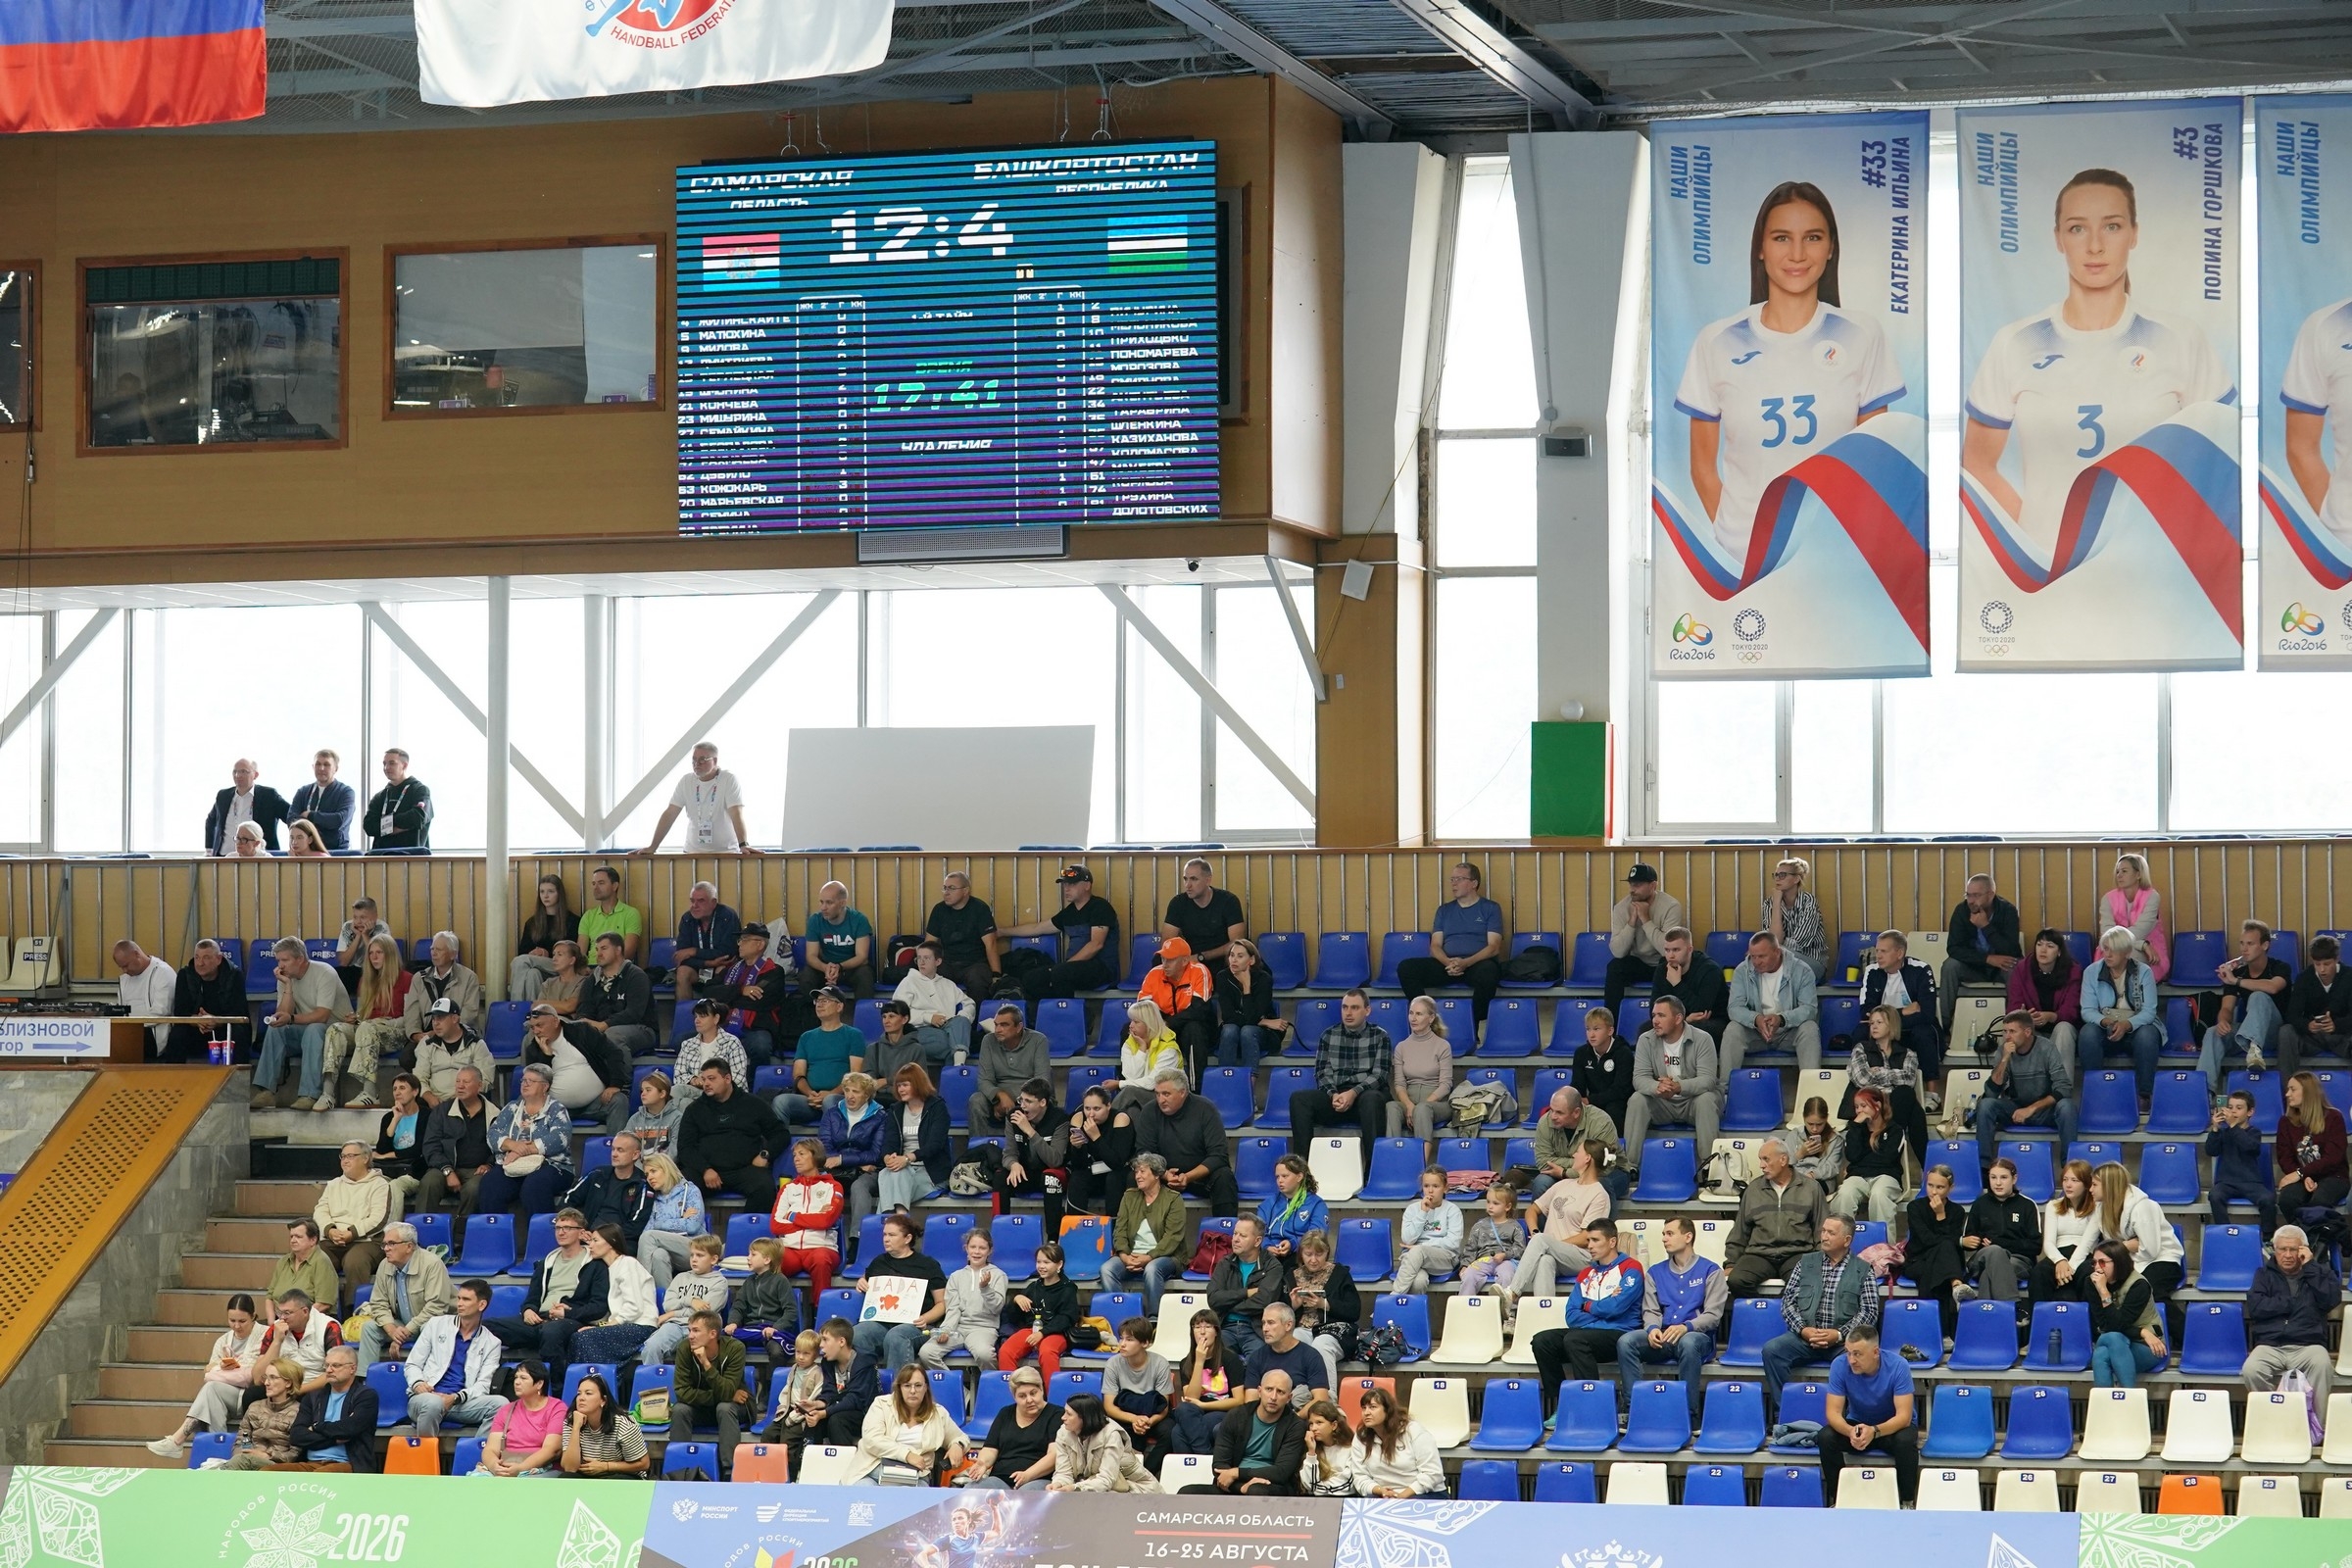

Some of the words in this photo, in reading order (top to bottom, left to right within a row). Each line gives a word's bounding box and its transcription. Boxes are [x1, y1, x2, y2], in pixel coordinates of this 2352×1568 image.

[610, 25, 679, 49] HANDBALL
[681, 0, 736, 44] FEDERAT
[2173, 125, 2199, 161] #3
[2277, 122, 2295, 176] НАШИ
[973, 152, 1200, 180] БАШКОРТОСТАН
[1861, 139, 1887, 189] #33
[1977, 131, 1994, 186] НАШИ
[1670, 145, 1689, 200] НАШИ
[1891, 136, 1910, 209] ИЛЬИНА
[2203, 122, 2223, 221] ГОРШКОВА
[690, 170, 855, 194] САМАРСКАЯ
[2296, 121, 2321, 245] ОЛИМПИЙЦЫ
[1995, 131, 2019, 254] ОЛИМПИЙЦЫ
[730, 197, 808, 210] ОБЛАСТЬ
[1689, 144, 1713, 266] ОЛИМПИЙЦЫ
[829, 203, 1014, 264] 12:4
[1890, 215, 1909, 315] ЕКАТЕРИНА
[2203, 227, 2222, 301] ПОЛИНА
[1091, 315, 1102, 324] 8
[680, 331, 690, 341] 5
[699, 328, 767, 340] МАТЮХИНА
[1110, 347, 1199, 360] ПОНОМАРЕВА
[869, 379, 1002, 413] 17:41
[1088, 387, 1105, 396] 22
[1088, 400, 1106, 409] 34
[678, 416, 695, 424] 23
[1760, 394, 1818, 449] 33
[1110, 432, 1200, 444] КАЗИХАНОВА
[2076, 404, 2105, 459] 3
[700, 483, 767, 494] КОЖОКАРЬ
[1111, 504, 1208, 516] ДОЛОТОВСКИХ
[2278, 638, 2328, 651] Rio2016
[1669, 648, 1716, 661] Rio2016
[24, 953, 48, 961] PRESS
[260, 950, 276, 958] PRE
[312, 951, 336, 959] PRESS
[2012, 1212, 2021, 1223] 16
[2228, 1227, 2238, 1236] 28
[872, 1278, 918, 1294] LADA
[1805, 1385, 1816, 1394] 23
[218, 1494, 267, 1559] НАРОДОВ
[277, 1482, 338, 1501] РОССИИ
[1136, 1510, 1236, 1528] САМАРСКАЯ
[1240, 1513, 1315, 1528] ОБЛАСТЬ
[326, 1512, 410, 1562] 2026
[758, 1534, 804, 1548] РОССИИ
[1208, 1543, 1309, 1561] АВГУСТА
